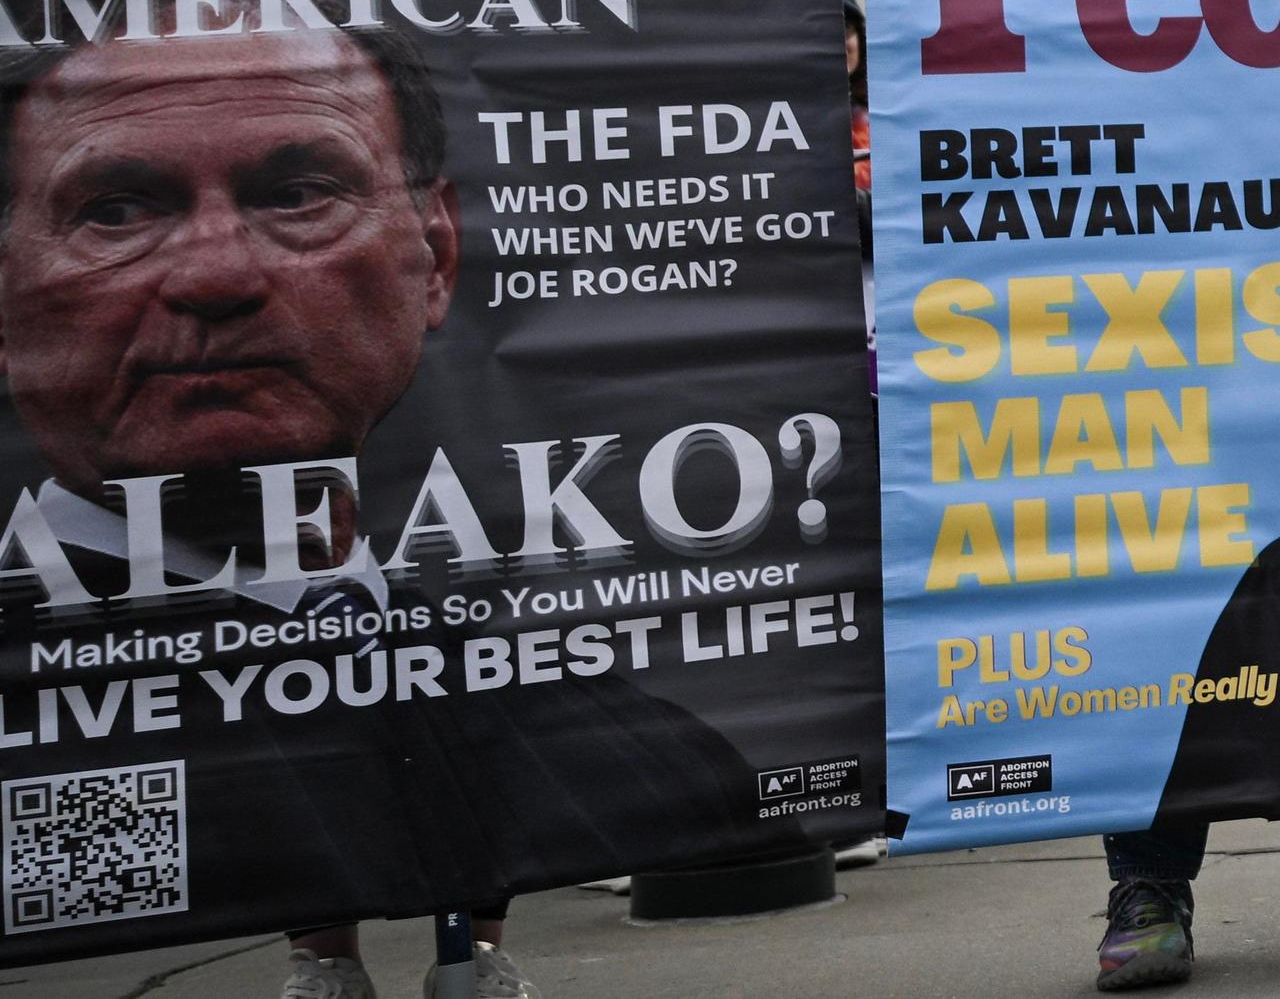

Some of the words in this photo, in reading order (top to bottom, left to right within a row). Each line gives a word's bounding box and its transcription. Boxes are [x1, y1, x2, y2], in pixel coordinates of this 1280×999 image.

[478, 107, 630, 164] THE
[659, 101, 810, 157] FDA
[919, 124, 1145, 182] BRETT
[488, 184, 588, 214] WHO
[602, 175, 729, 209] NEEDS
[742, 172, 775, 201] IT
[492, 225, 613, 255] WHEN
[625, 216, 743, 250] WE'VE
[756, 211, 835, 241] GOT
[488, 270, 558, 307] JOE
[572, 258, 738, 297] ROGAN?
[929, 387, 1210, 482] MAN
[924, 483, 1256, 592] ALIVE
[31, 629, 204, 673] Making
[214, 604, 431, 653] Decisions
[442, 594, 492, 626] So
[501, 587, 584, 617] You
[594, 569, 670, 607] Will
[681, 562, 799, 597] Never
[198, 644, 448, 722] YOUR
[464, 616, 662, 693] BEST
[682, 591, 860, 664] LIFE!
[936, 626, 1093, 688] PLUS
[935, 694, 1008, 728] Are
[1015, 681, 1161, 720] Women
[1167, 666, 1279, 706] Really
[767, 774, 797, 793] AAF
[809, 759, 859, 774] ABORTION
[810, 770, 848, 783] ACCESS
[810, 780, 842, 791] FRONT
[957, 771, 988, 790] AAF
[1000, 760, 1050, 773] ABORTION
[1000, 770, 1039, 782] ACCESS
[1000, 780, 1033, 791] FRONT
[758, 791, 862, 819] aafront.org
[950, 794, 1072, 821] aafront.org
